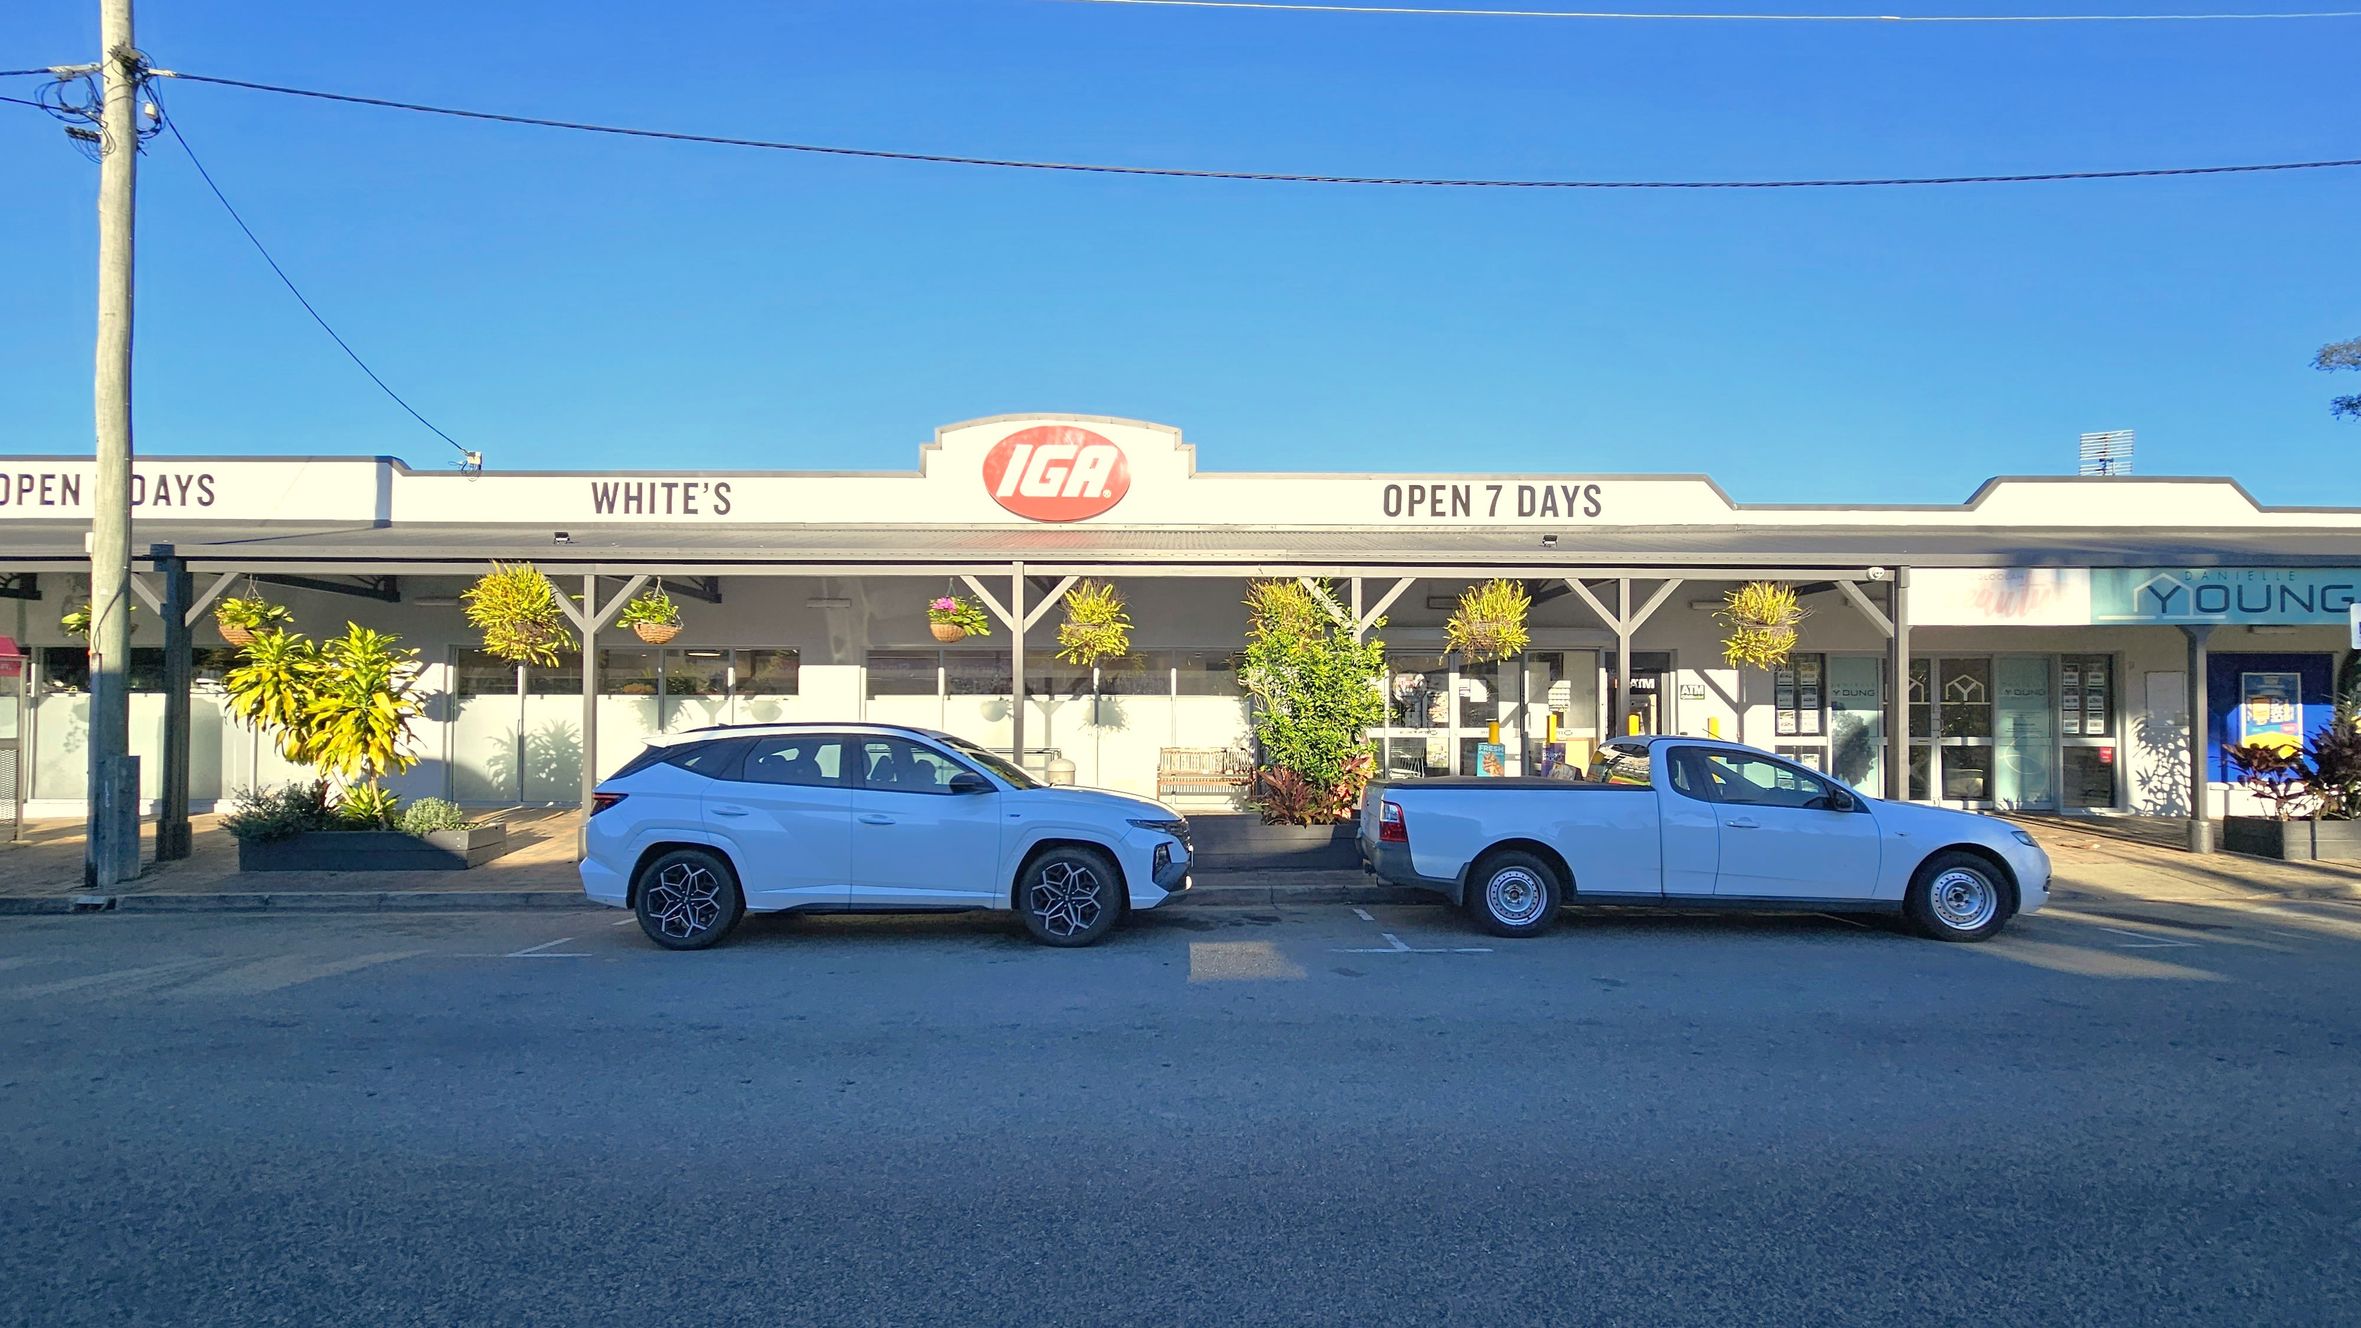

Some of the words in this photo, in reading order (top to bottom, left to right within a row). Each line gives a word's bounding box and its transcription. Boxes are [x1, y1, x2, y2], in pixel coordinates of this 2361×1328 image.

[995, 443, 1119, 498] IGA
[0, 473, 80, 506] OPEN
[131, 474, 215, 506] DAYS
[591, 481, 732, 516] WHITE'S
[1383, 484, 1471, 518] OPEN
[1485, 484, 1503, 517] 7
[1517, 484, 1602, 518] DAYS
[2184, 570, 2296, 581] DANIELLE
[2147, 584, 2356, 614] YOUNG
[1630, 678, 1655, 689] ATM
[1681, 685, 1704, 696] ATM
